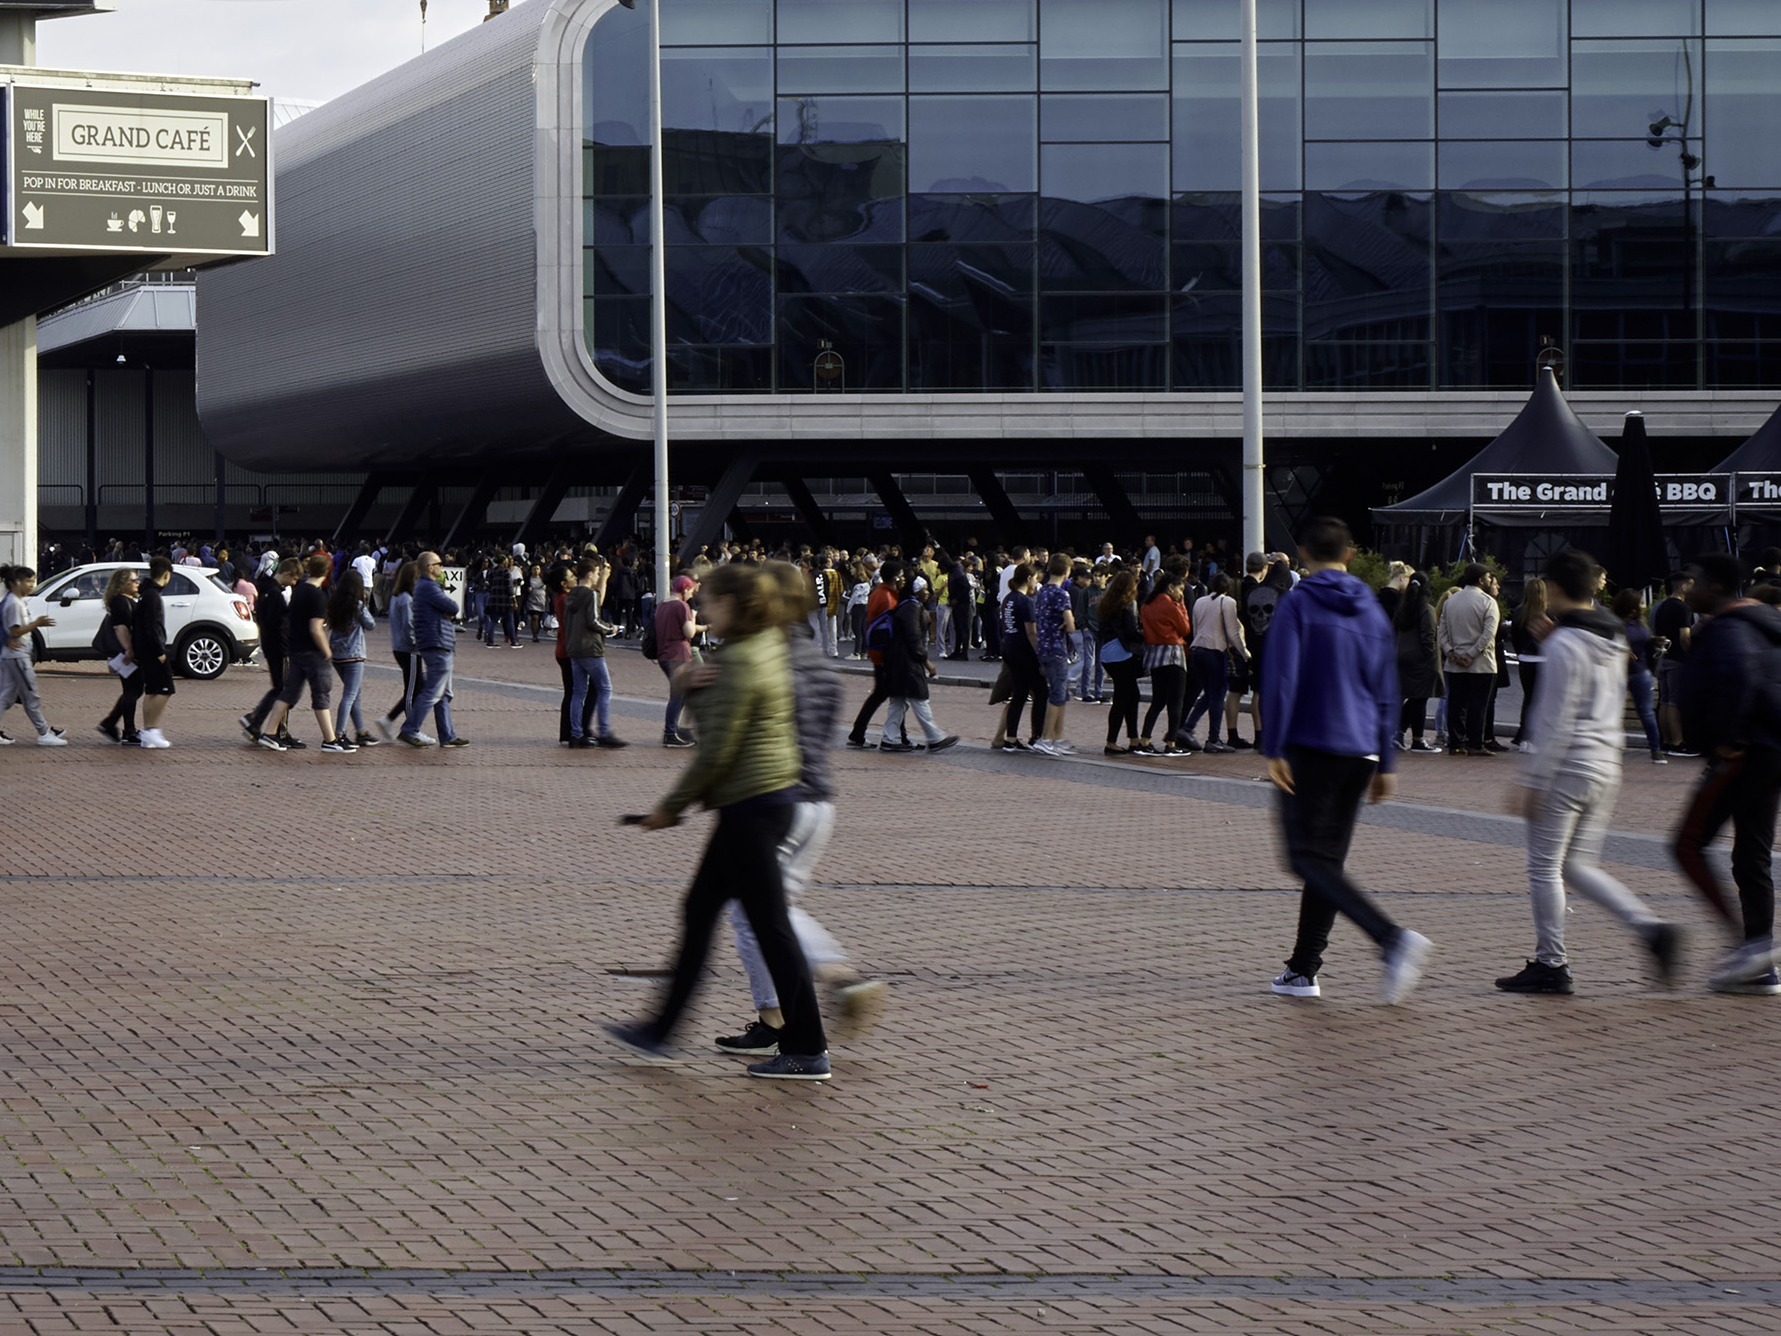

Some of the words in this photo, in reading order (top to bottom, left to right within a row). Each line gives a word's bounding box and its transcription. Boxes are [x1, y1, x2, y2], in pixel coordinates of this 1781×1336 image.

[24, 108, 44, 121] WHILE
[23, 120, 45, 132] YOU'RE
[26, 131, 43, 143] HERE
[71, 124, 150, 149] GRAND
[155, 126, 211, 152] CAFÉ
[24, 177, 44, 189] POP
[45, 178, 55, 189] IN
[57, 178, 78, 190] FOR
[79, 179, 136, 192] BREAKFAST
[142, 182, 177, 195] LUNCH
[177, 184, 192, 195] OR
[193, 184, 216, 196] JUST
[217, 185, 225, 196] A
[226, 185, 257, 197] DRINK
[1487, 482, 1531, 501] The
[1536, 482, 1607, 501] Grand
[1667, 482, 1717, 502] BBQ
[443, 570, 463, 581] AXI
